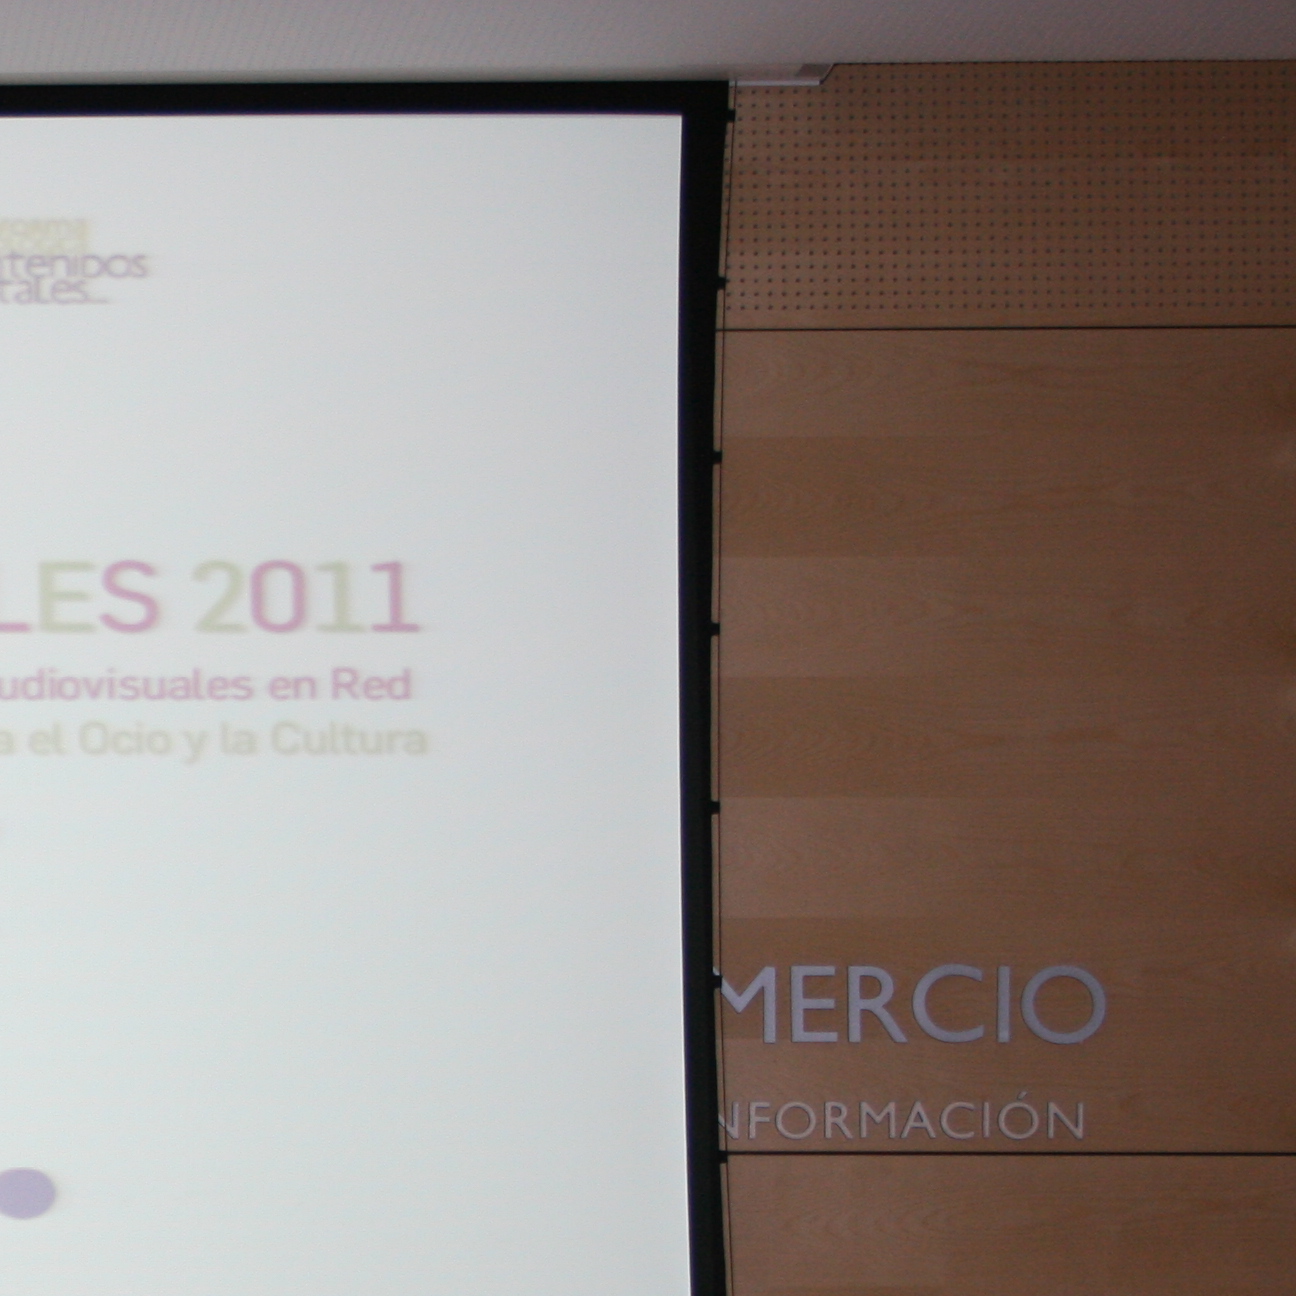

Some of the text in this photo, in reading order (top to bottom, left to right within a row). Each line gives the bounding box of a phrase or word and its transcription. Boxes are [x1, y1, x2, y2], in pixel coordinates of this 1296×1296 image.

[189, 560, 421, 634] 2011
[267, 675, 316, 700] en
[332, 667, 412, 701] Red
[29, 722, 64, 757] el
[78, 722, 171, 757] Ocio
[181, 731, 205, 764] y
[221, 722, 258, 757] la
[270, 722, 427, 757] Cultura
